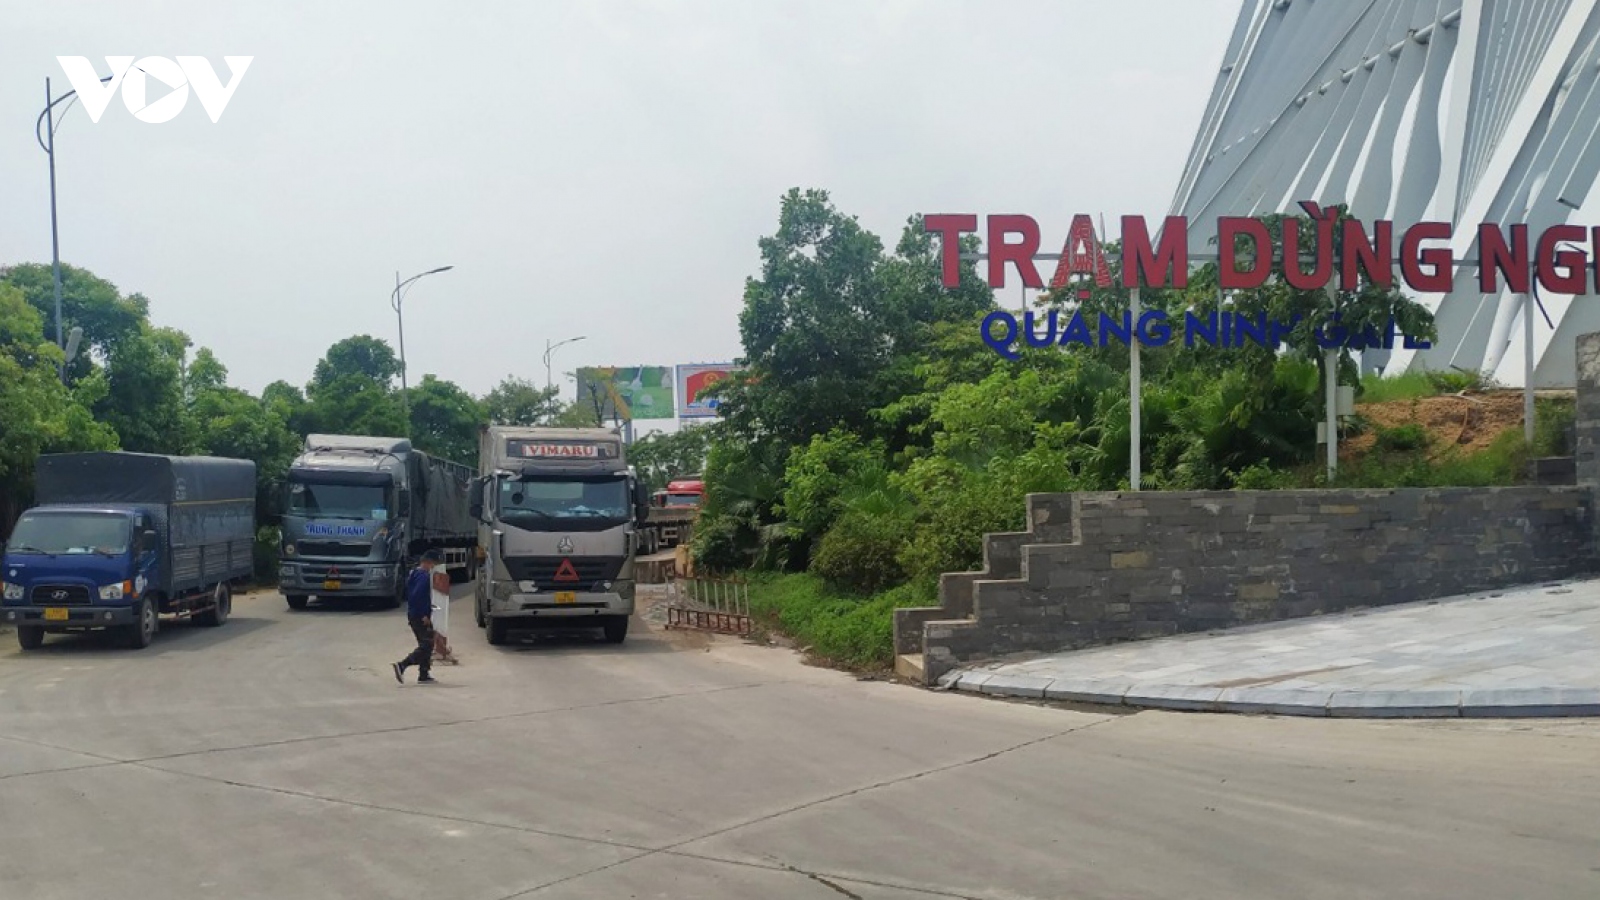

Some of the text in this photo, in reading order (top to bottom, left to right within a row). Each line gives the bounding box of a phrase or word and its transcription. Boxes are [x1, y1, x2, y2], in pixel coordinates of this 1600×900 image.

[924, 200, 1600, 299] TRẠM DỪNG NG
[980, 310, 1172, 361] QUANG
[528, 444, 594, 457] VIMARU
